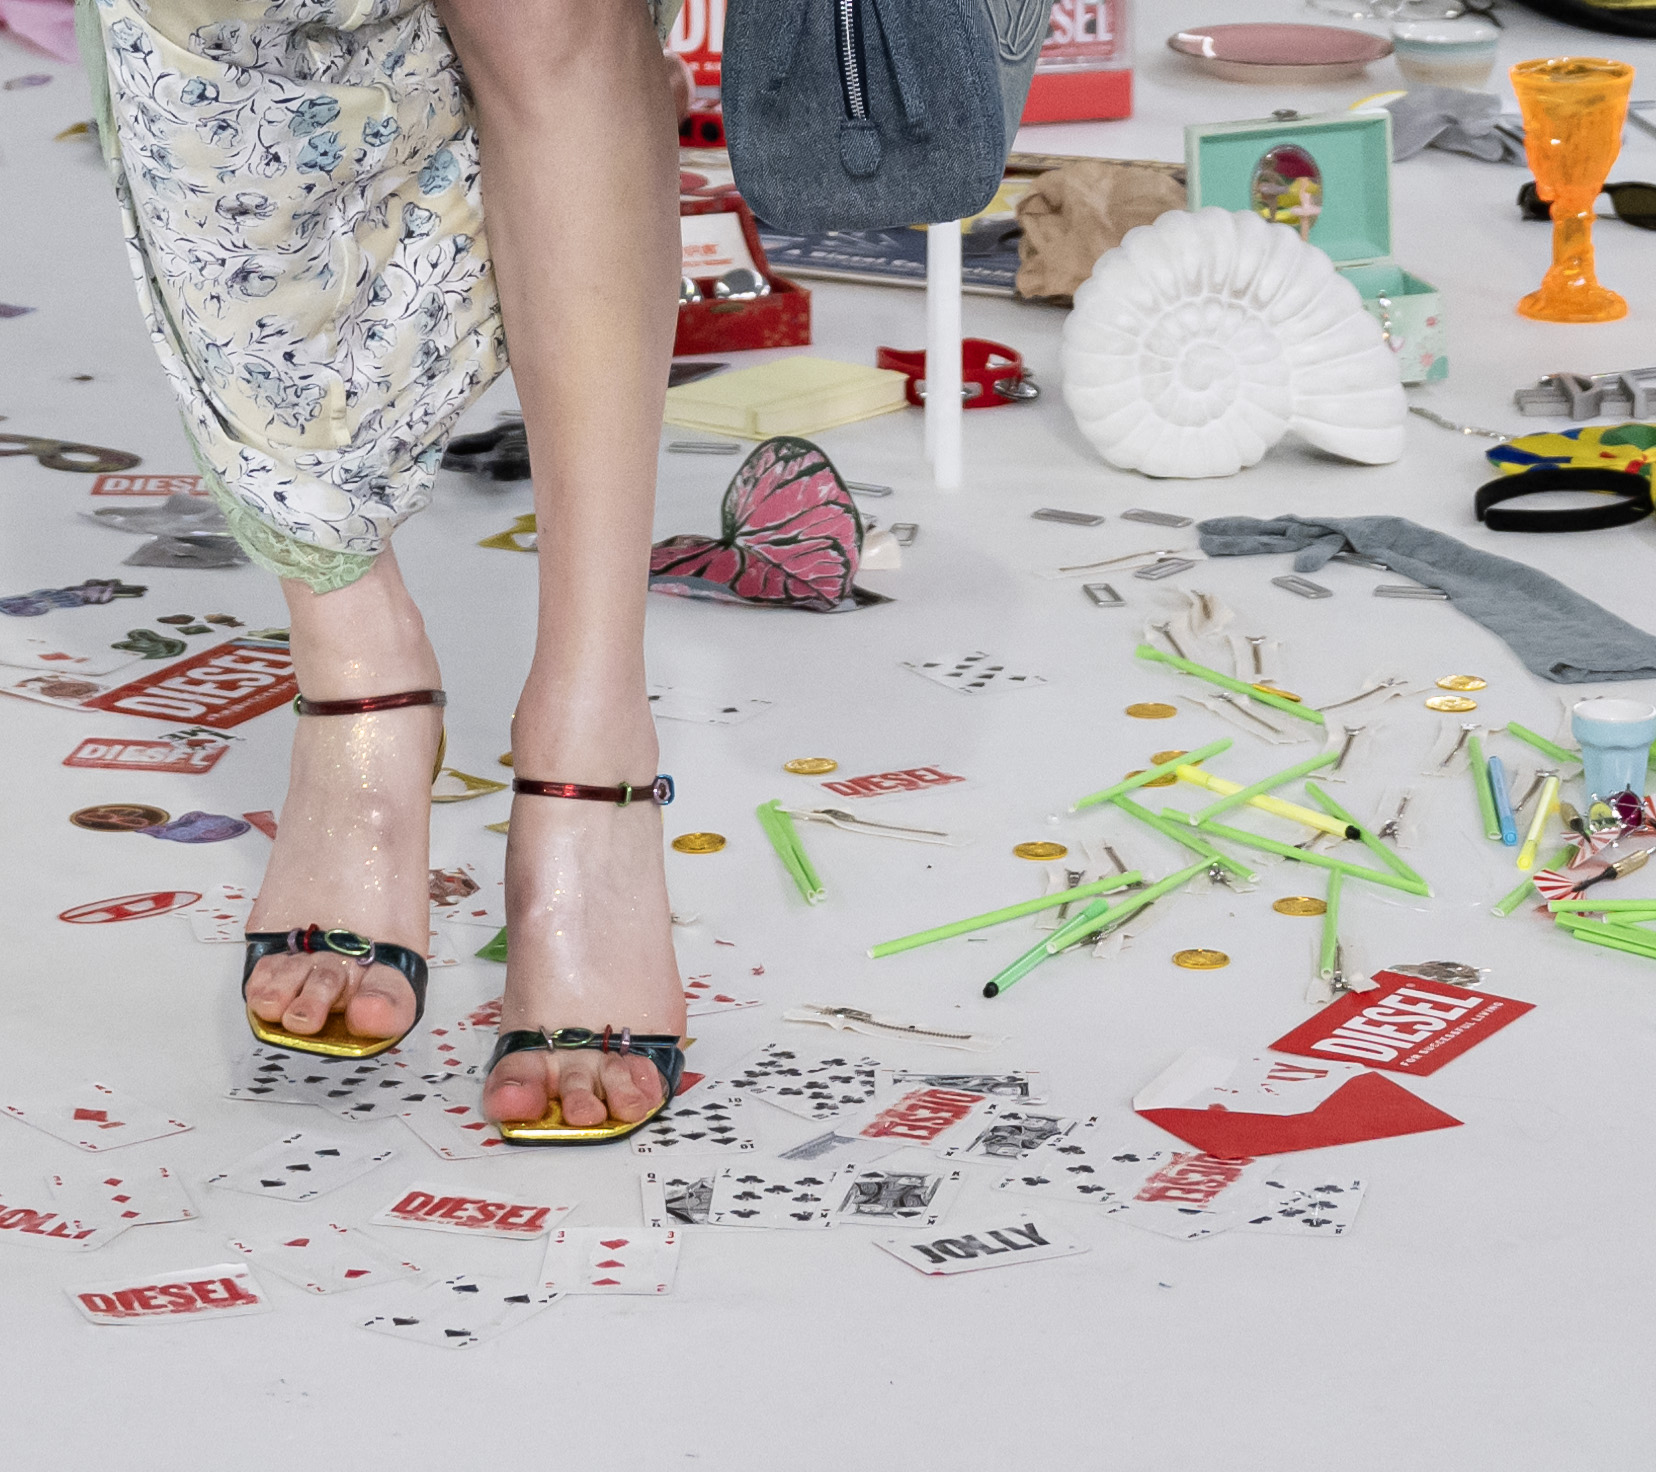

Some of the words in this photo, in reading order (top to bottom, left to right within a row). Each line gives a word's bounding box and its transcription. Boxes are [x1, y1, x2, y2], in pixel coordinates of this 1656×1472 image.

[821, 766, 963, 798] DIESEL
[1310, 986, 1485, 1064] DIESEL
[390, 1190, 552, 1232] DIESEL
[912, 1221, 1051, 1264] JOLLY
[78, 1277, 260, 1317] DIESEL
